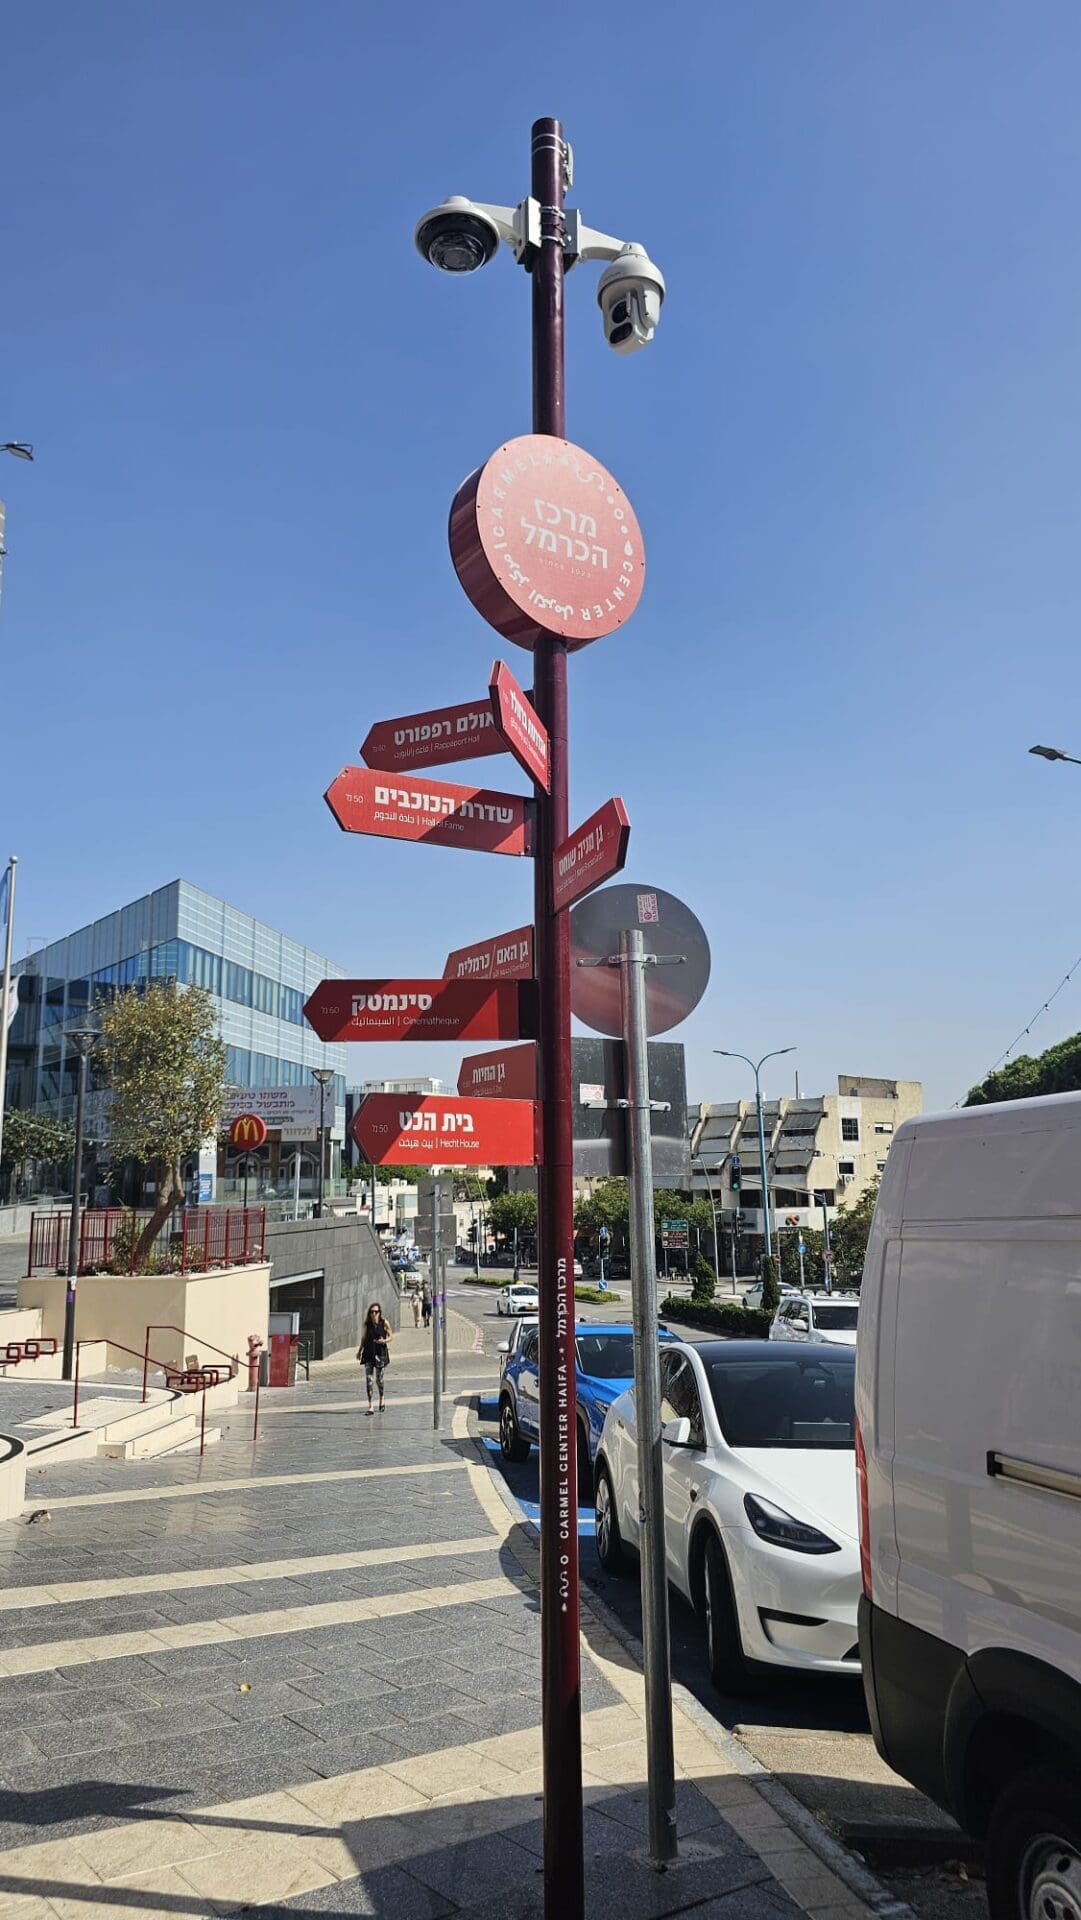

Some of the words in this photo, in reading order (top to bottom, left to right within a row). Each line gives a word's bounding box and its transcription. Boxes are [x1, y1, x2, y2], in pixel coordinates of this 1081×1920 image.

[534, 498, 597, 538] מרכז
[491, 454, 540, 538] CARMEL
[580, 560, 634, 621] CENTER
[521, 515, 608, 568] הכרמל
[394, 720, 452, 746] רפפורט
[375, 786, 455, 815] הכוכבים
[460, 801, 513, 824] שדרת
[444, 820, 464, 831] Fame
[496, 944, 517, 964] האם
[520, 941, 529, 962] גן
[457, 953, 490, 977] כרמלית
[352, 994, 432, 1016] סינמטק
[403, 1016, 460, 1026] Cinematheque
[472, 1065, 496, 1083] החיות
[497, 1063, 505, 1082] גן
[400, 1111, 437, 1131] הכט
[441, 1112, 475, 1132] בית
[440, 1138, 458, 1148] Hecht
[459, 1139, 480, 1148] House
[557, 1258, 567, 1290] מרכז
[558, 1364, 568, 1407] HAIFA
[558, 1414, 568, 1472] CENTER
[559, 1477, 569, 1539] CARMEL
